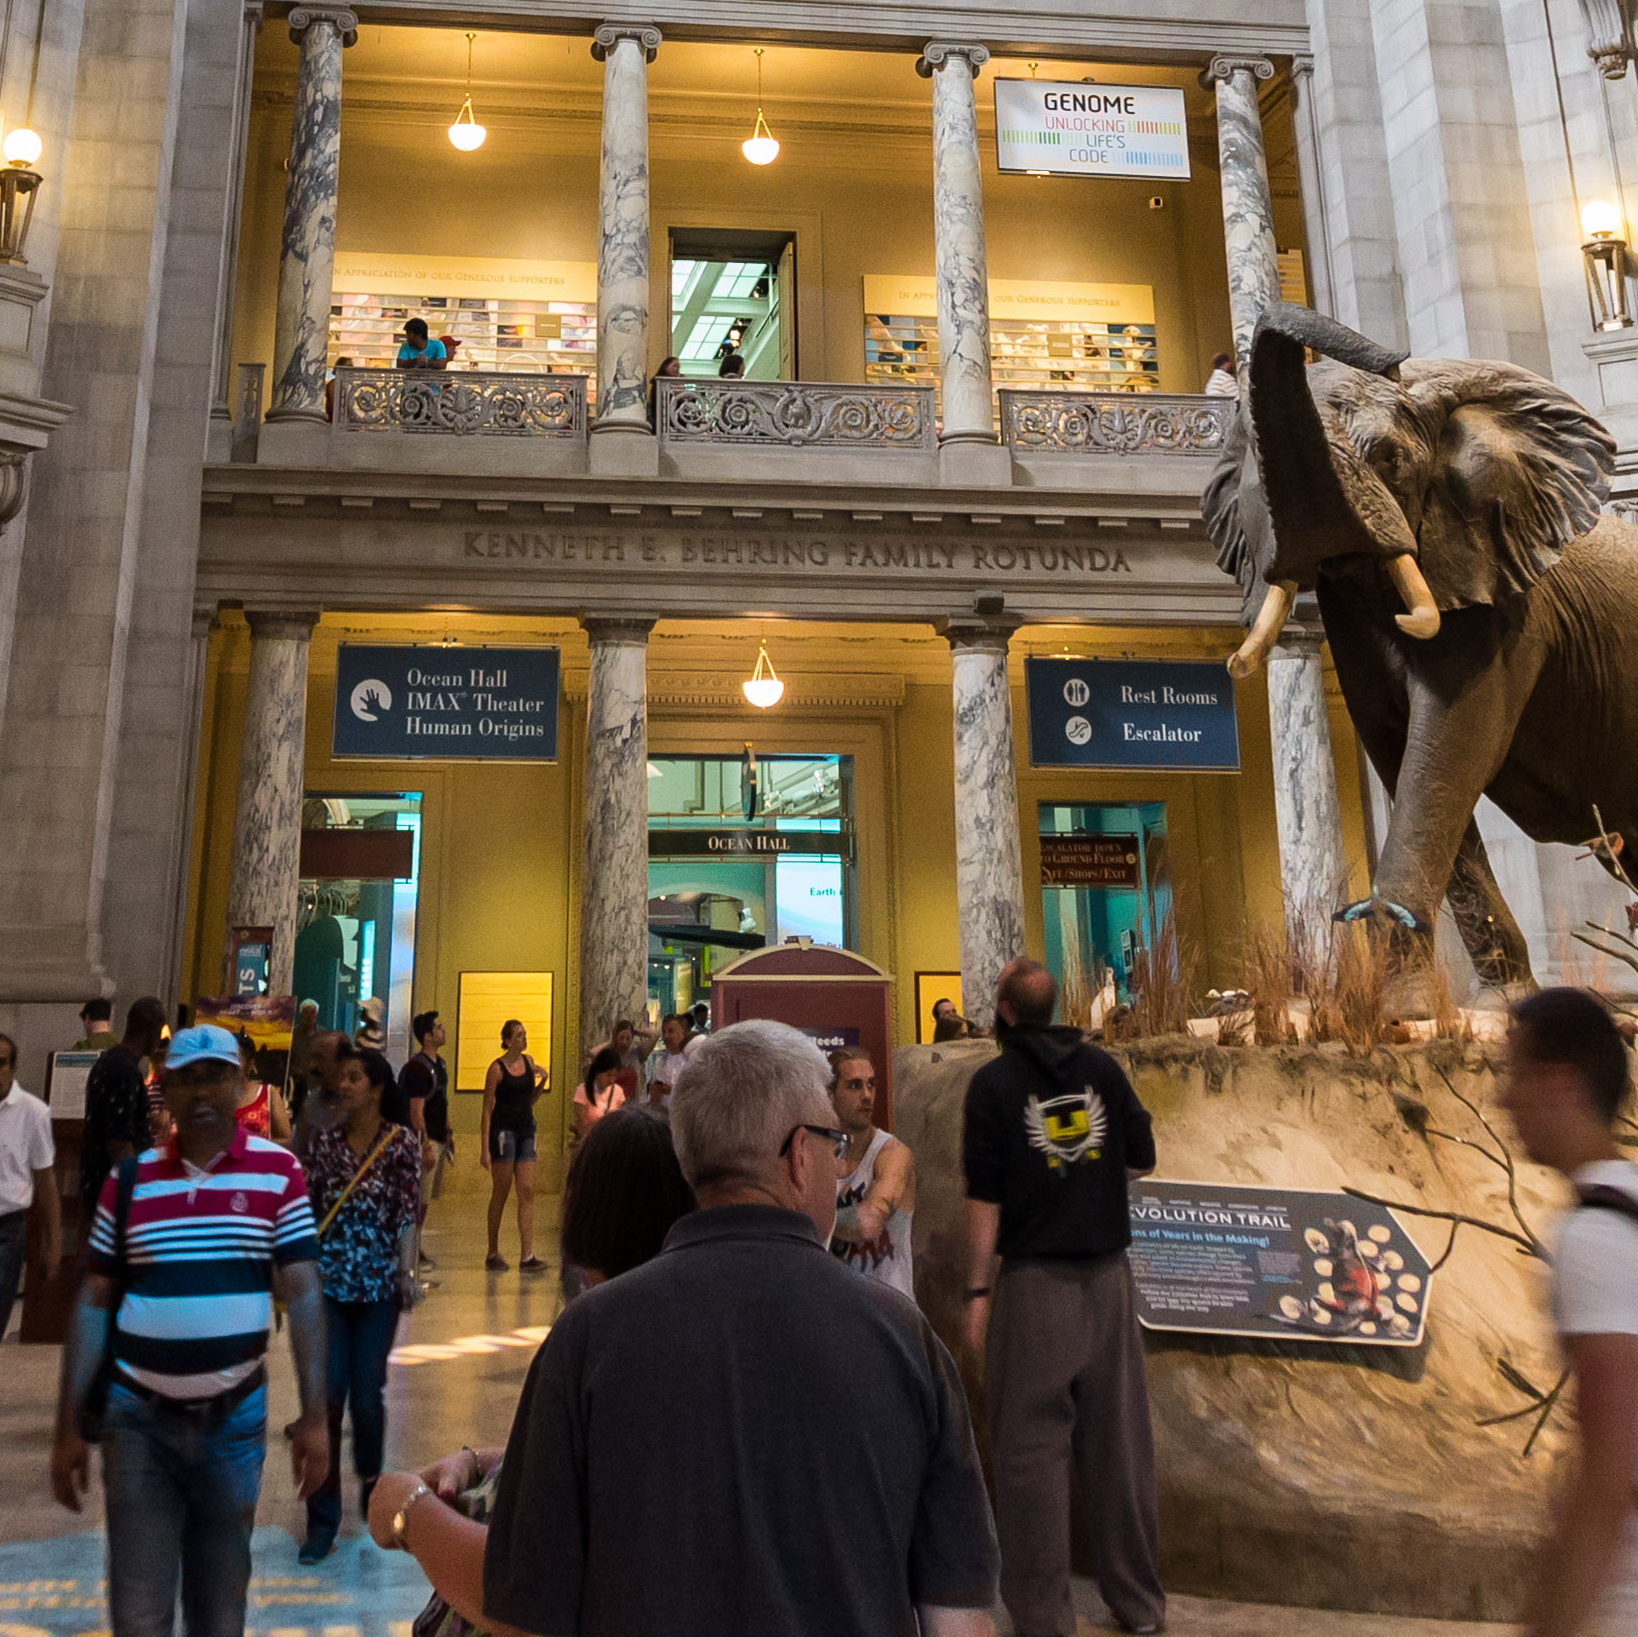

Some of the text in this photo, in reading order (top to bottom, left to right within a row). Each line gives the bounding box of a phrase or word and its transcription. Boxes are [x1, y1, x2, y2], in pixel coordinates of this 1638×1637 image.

[1044, 93, 1135, 114] GENOME
[1045, 116, 1125, 133] UNLOCKING
[1086, 134, 1126, 149] LIFE'S
[1069, 148, 1109, 163] CODE
[344, 268, 412, 279] APPRECIATION
[455, 271, 505, 283] GENEROUS
[508, 273, 566, 286] SUPPORTERS
[463, 532, 1132, 572] KENNETH E. BEHRING FAMILY ROTUNDA
[407, 668, 507, 688] Ocean Hall
[473, 693, 545, 712] Theater
[1121, 685, 1218, 705] Rest Rooms
[406, 716, 544, 741] Human Origins
[1123, 723, 1202, 742] Escalator
[708, 835, 791, 850] OCEAN HALL
[810, 887, 836, 896] Earth
[816, 1036, 845, 1046] eeds
[1236, 1213, 1291, 1229] TRAIL
[1149, 1229, 1160, 1238] of
[1162, 1230, 1190, 1241] Years
[1192, 1232, 1204, 1242] in
[1205, 1232, 1223, 1243] the
[1225, 1233, 1270, 1248] Making!
